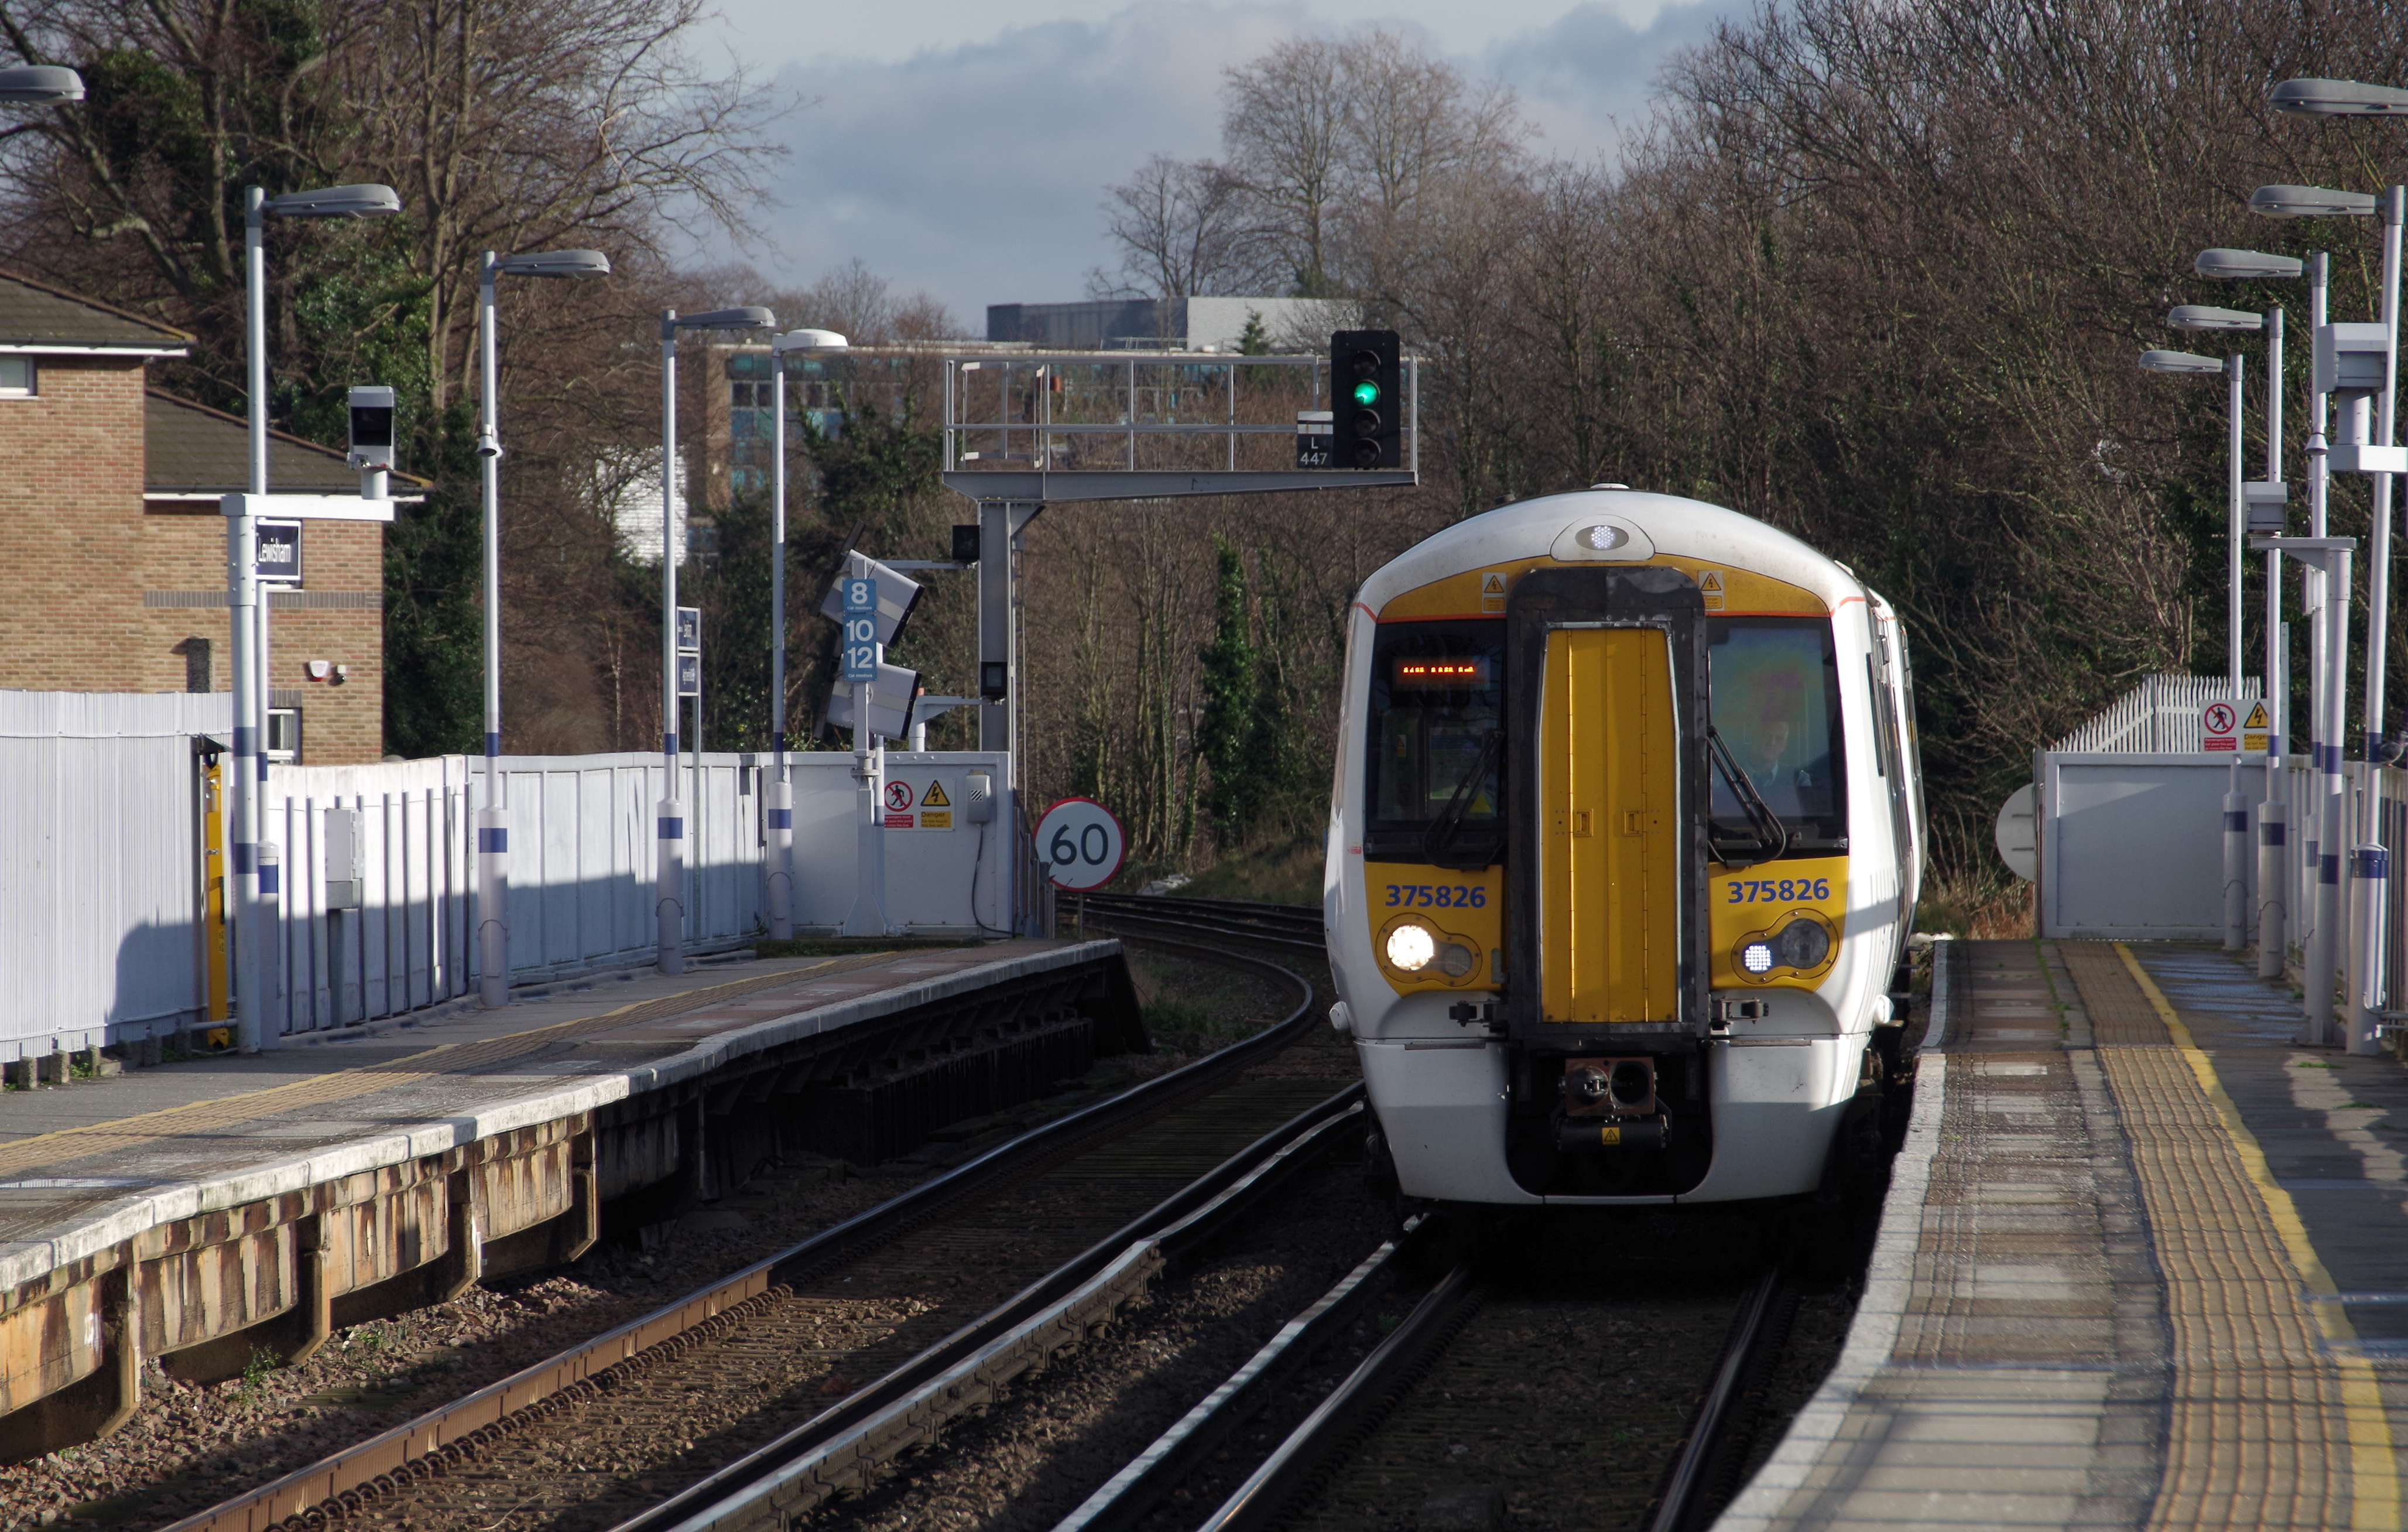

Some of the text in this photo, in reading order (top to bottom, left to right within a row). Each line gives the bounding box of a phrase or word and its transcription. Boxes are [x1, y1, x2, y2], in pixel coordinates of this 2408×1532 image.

[1311, 436, 1318, 449] L
[1300, 452, 1328, 466] 447
[258, 537, 292, 563] Lewisham
[851, 582, 868, 604] 8
[846, 619, 874, 642] 10
[847, 646, 873, 669] 12
[1050, 823, 1109, 866] 60
[1385, 884, 1486, 909] 375826
[1727, 878, 1830, 904] 375826
